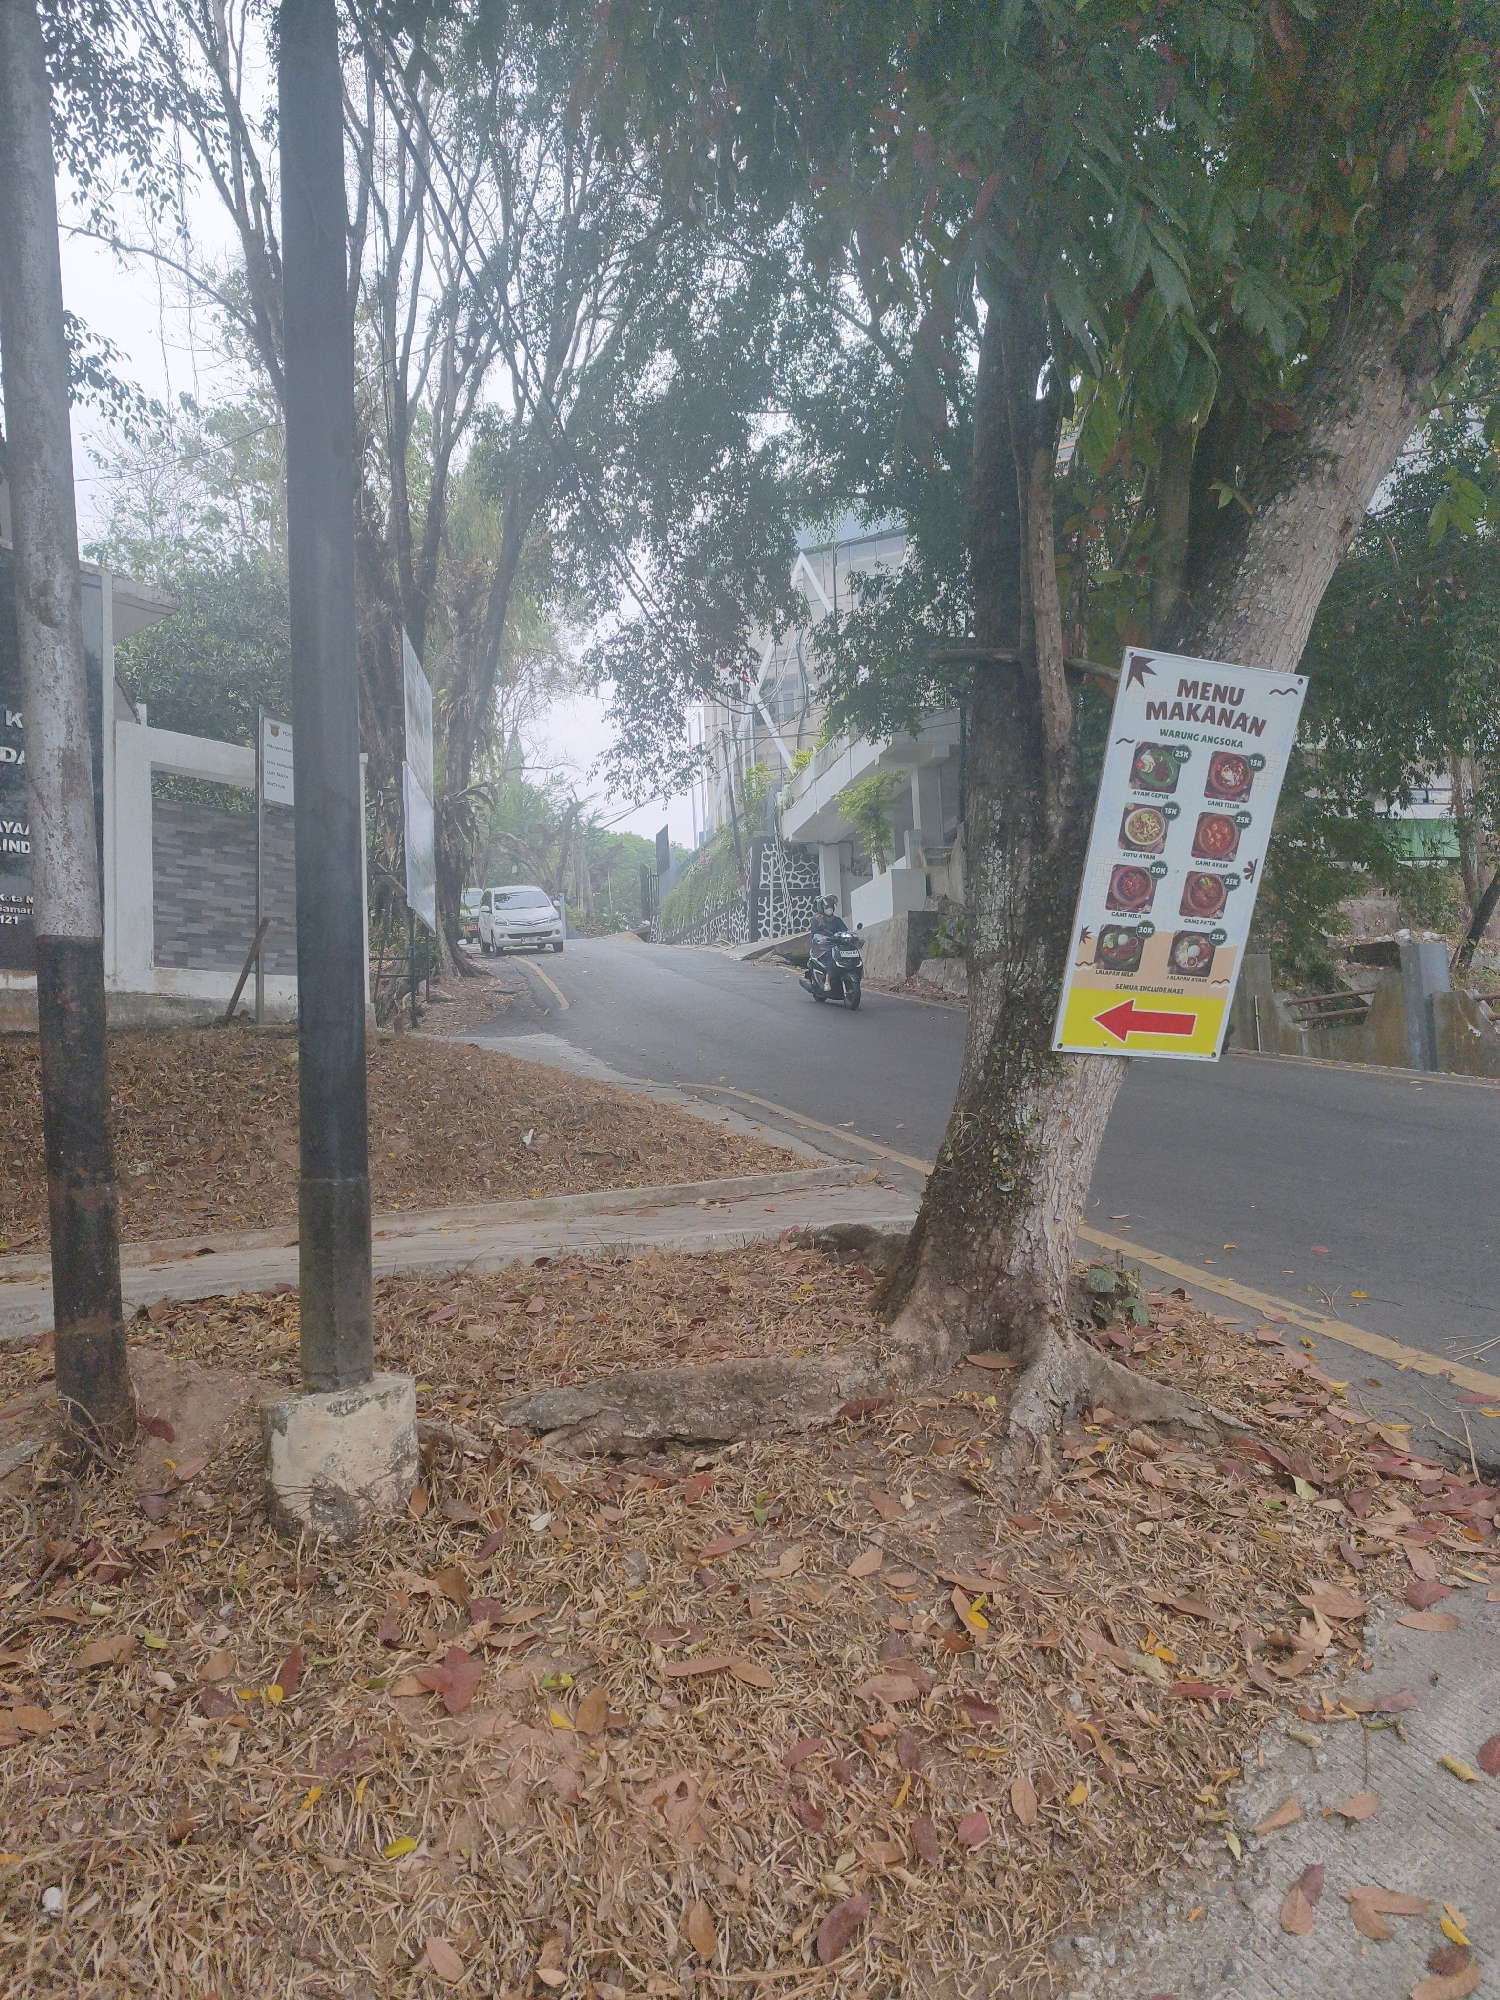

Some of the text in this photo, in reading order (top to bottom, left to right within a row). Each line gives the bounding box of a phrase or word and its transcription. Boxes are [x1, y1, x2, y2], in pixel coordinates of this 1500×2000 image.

[1177, 679, 1245, 706] MENU
[1146, 702, 1267, 738] MAKANAN
[1160, 729, 1243, 748] WARUNG ANGSOKA
[1175, 750, 1189, 759] 25K
[1250, 759, 1262, 767] 15K
[1164, 807, 1178, 815] 15K
[1236, 816, 1250, 824] 25K
[1151, 866, 1166, 875] 30K
[1138, 926, 1153, 935] 30K
[1211, 933, 1226, 941] 25K
